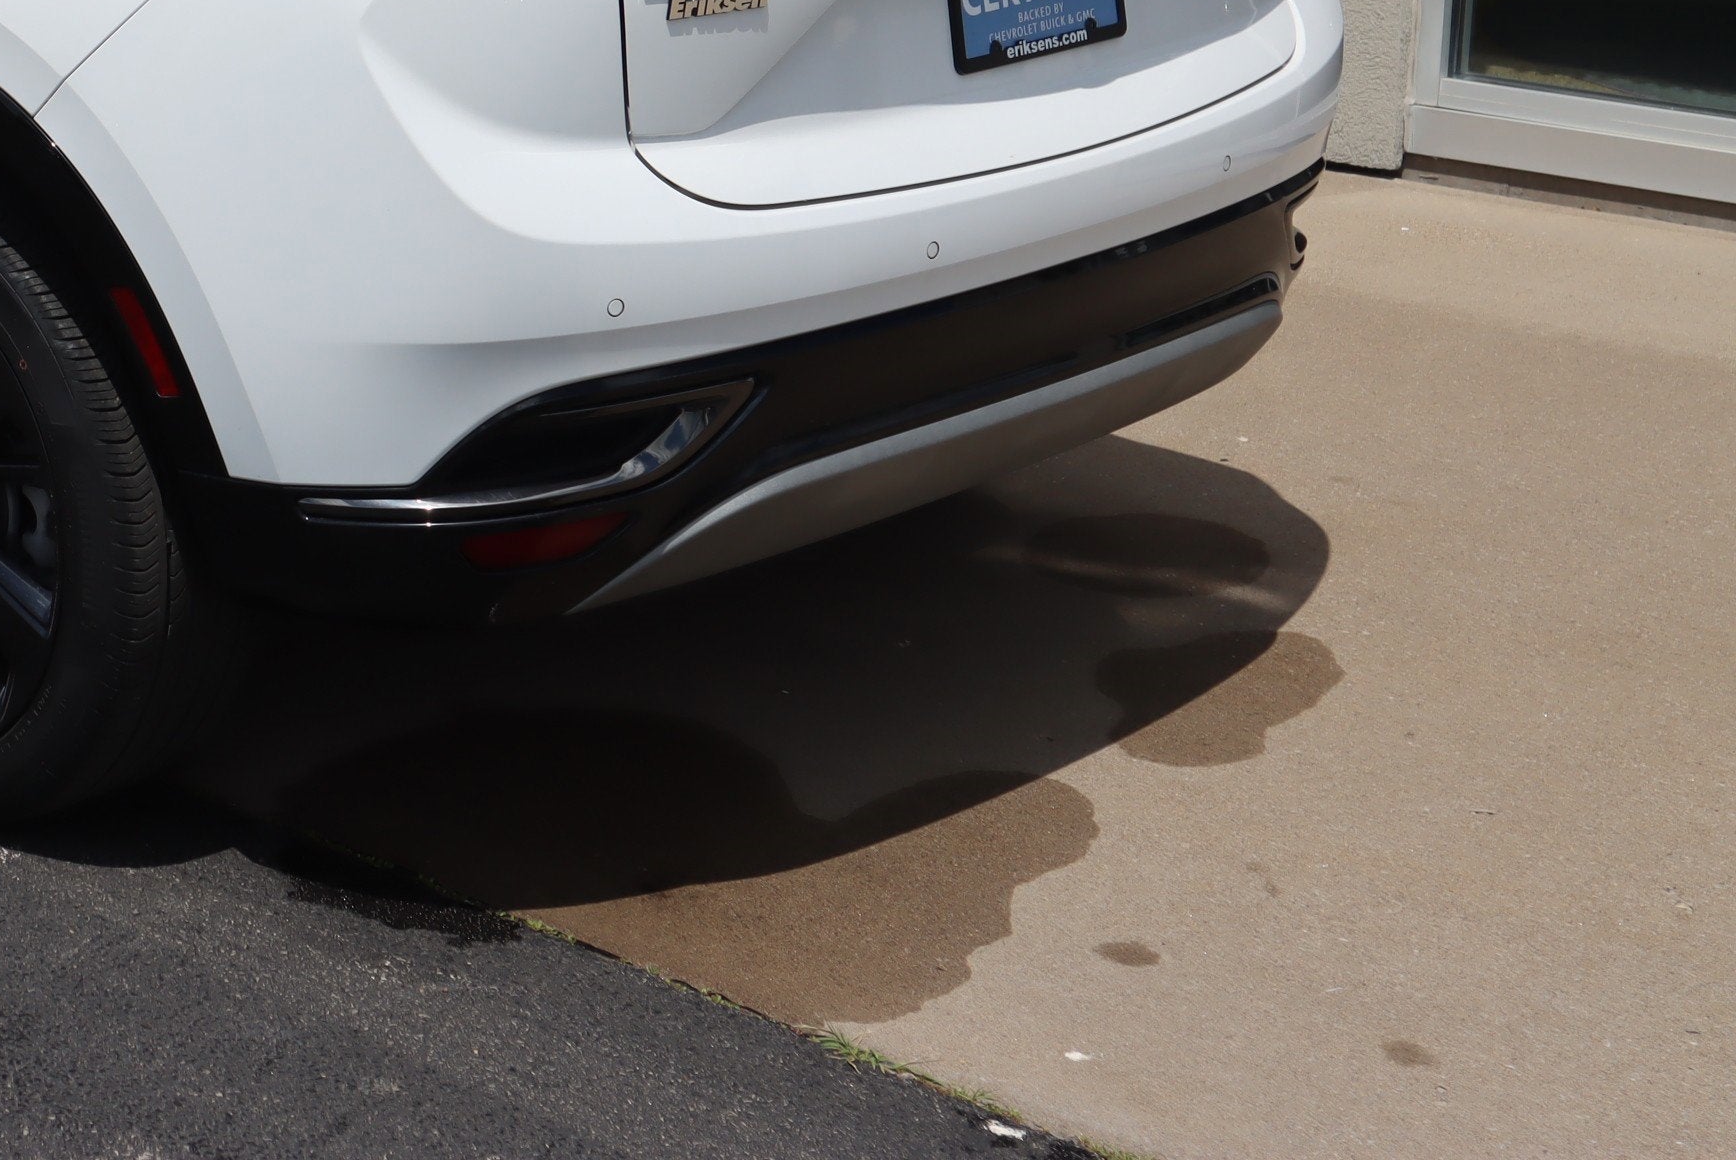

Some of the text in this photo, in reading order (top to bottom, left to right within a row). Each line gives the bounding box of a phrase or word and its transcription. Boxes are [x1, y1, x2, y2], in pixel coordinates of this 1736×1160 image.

[989, 8, 1095, 43] CHEVROLET BUICK & GMC
[1017, 2, 1064, 23] BACKED BY
[1006, 28, 1088, 59] eriksens.com
